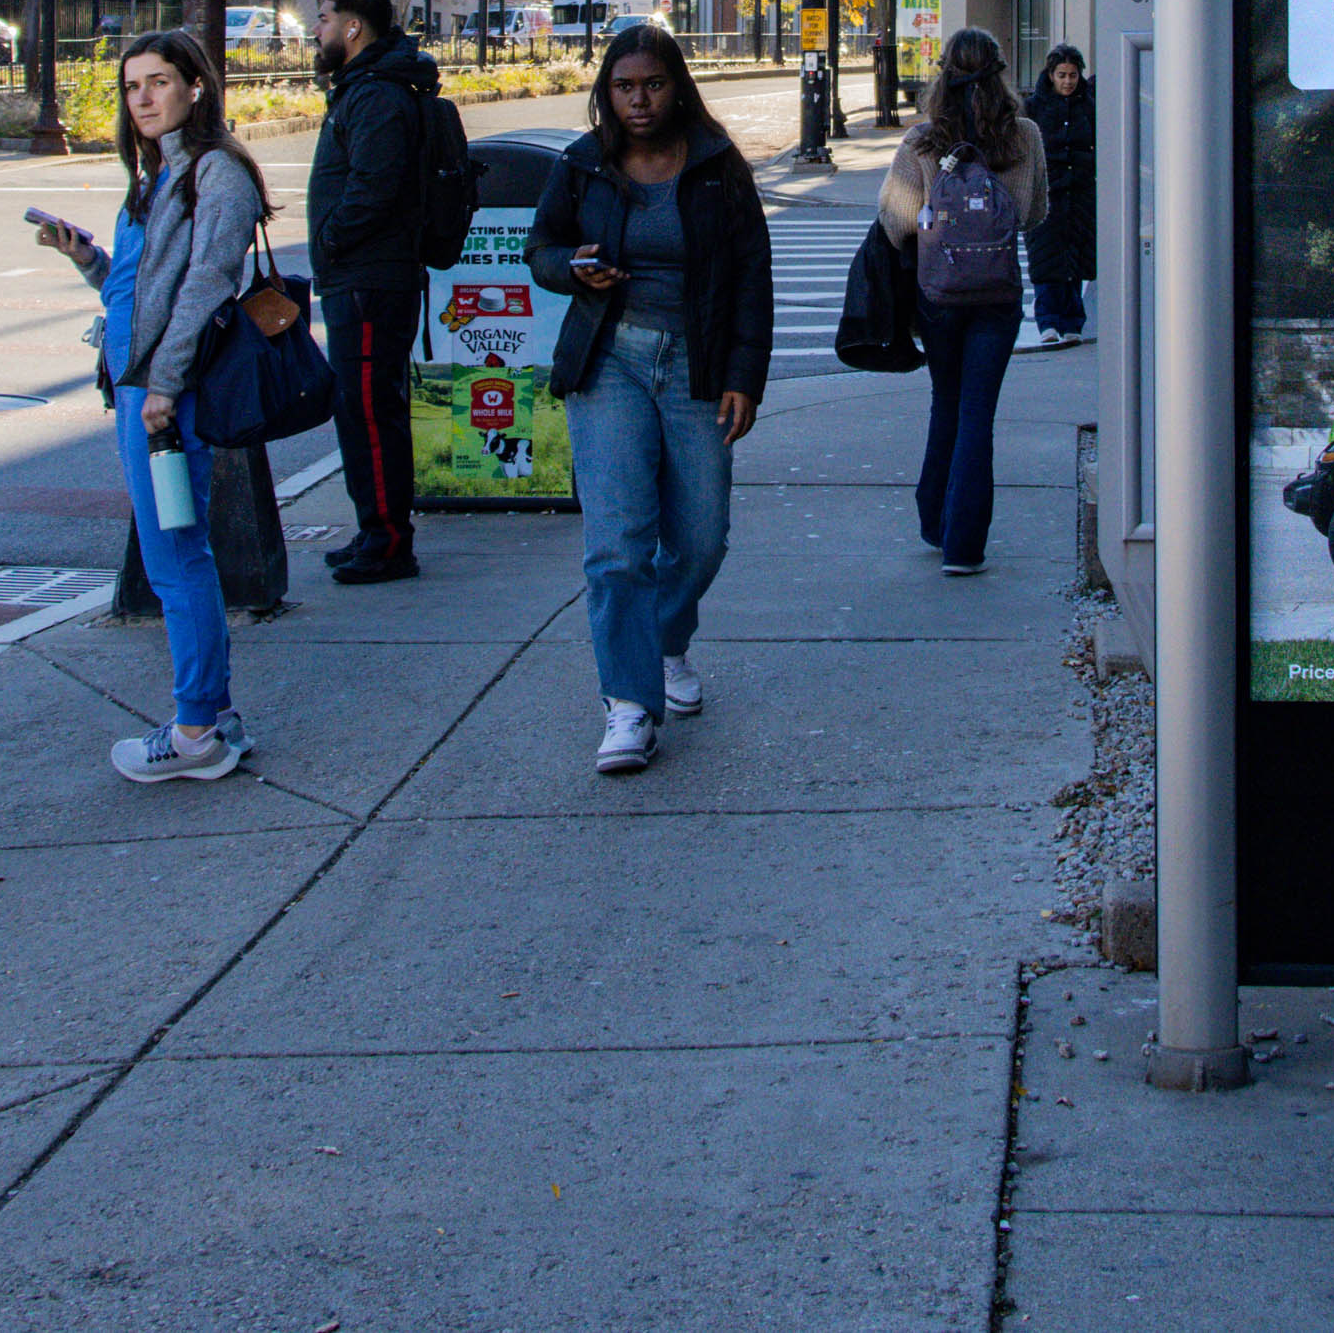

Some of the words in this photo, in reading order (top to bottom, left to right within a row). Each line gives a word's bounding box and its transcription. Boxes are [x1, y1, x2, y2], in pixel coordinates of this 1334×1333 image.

[463, 237, 488, 250] UR
[457, 255, 492, 264] MES
[460, 329, 527, 343] ORGANIC
[466, 340, 521, 354] VALLEY
[473, 409, 495, 417] WHOLE
[497, 409, 513, 417] MILK
